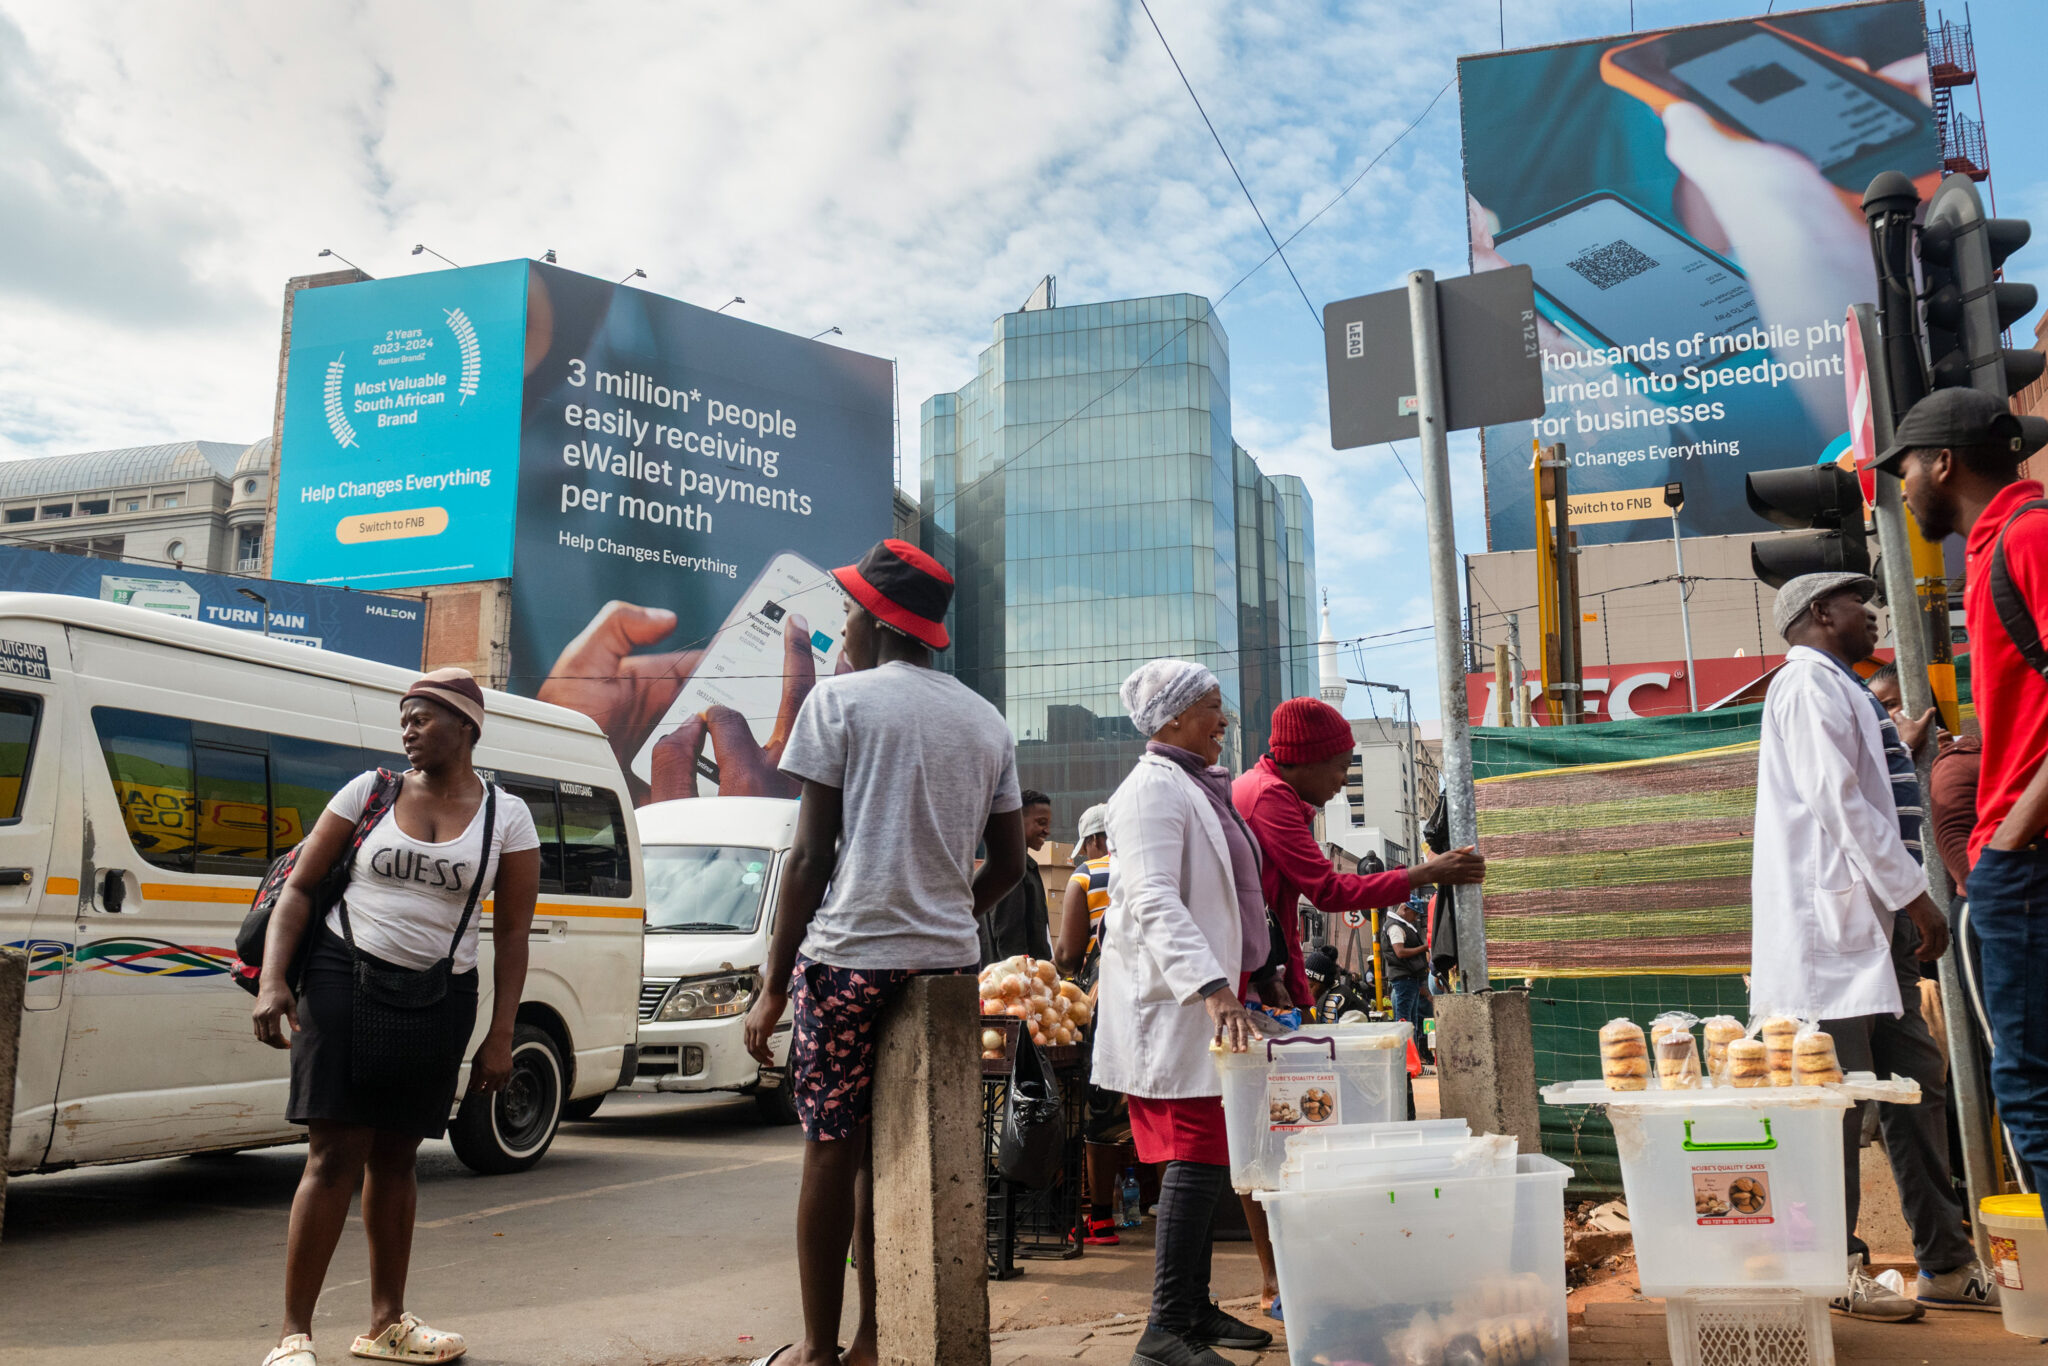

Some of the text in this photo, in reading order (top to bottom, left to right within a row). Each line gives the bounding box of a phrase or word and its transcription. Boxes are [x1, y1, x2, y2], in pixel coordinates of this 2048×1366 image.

[372, 337, 434, 356] 2023-2024
[386, 328, 423, 341] 2 Years
[1521, 309, 1538, 359] R 12 21
[378, 356, 401, 367] Kantar
[1539, 335, 1670, 372] housands
[1675, 332, 1705, 358] of
[1709, 326, 1800, 355] mobile
[354, 372, 447, 397] Most Valuable
[1543, 353, 1845, 406] urned into Speedpoint
[354, 391, 446, 414] South African
[567, 358, 587, 388] 3
[707, 398, 797, 439] people
[377, 409, 418, 428] Brand
[1531, 401, 1726, 438] for businesses
[564, 402, 780, 478] easily receiving
[1575, 446, 1647, 469] Changes
[1649, 438, 1740, 461] Everything
[301, 467, 492, 504] Help Changes Everything
[562, 440, 813, 516] eWallet payments
[561, 483, 713, 534] per month
[1567, 496, 1653, 516] Switch to FNB
[359, 516, 425, 533] Switch to FNB
[558, 529, 739, 579] Help Changes Everything
[206, 605, 305, 629] TURN PAIN
[366, 604, 417, 621] HALEON
[0, 639, 44, 661] UITGANG
[25, 660, 46, 678] EXIT
[371, 847, 467, 891] GUESS
